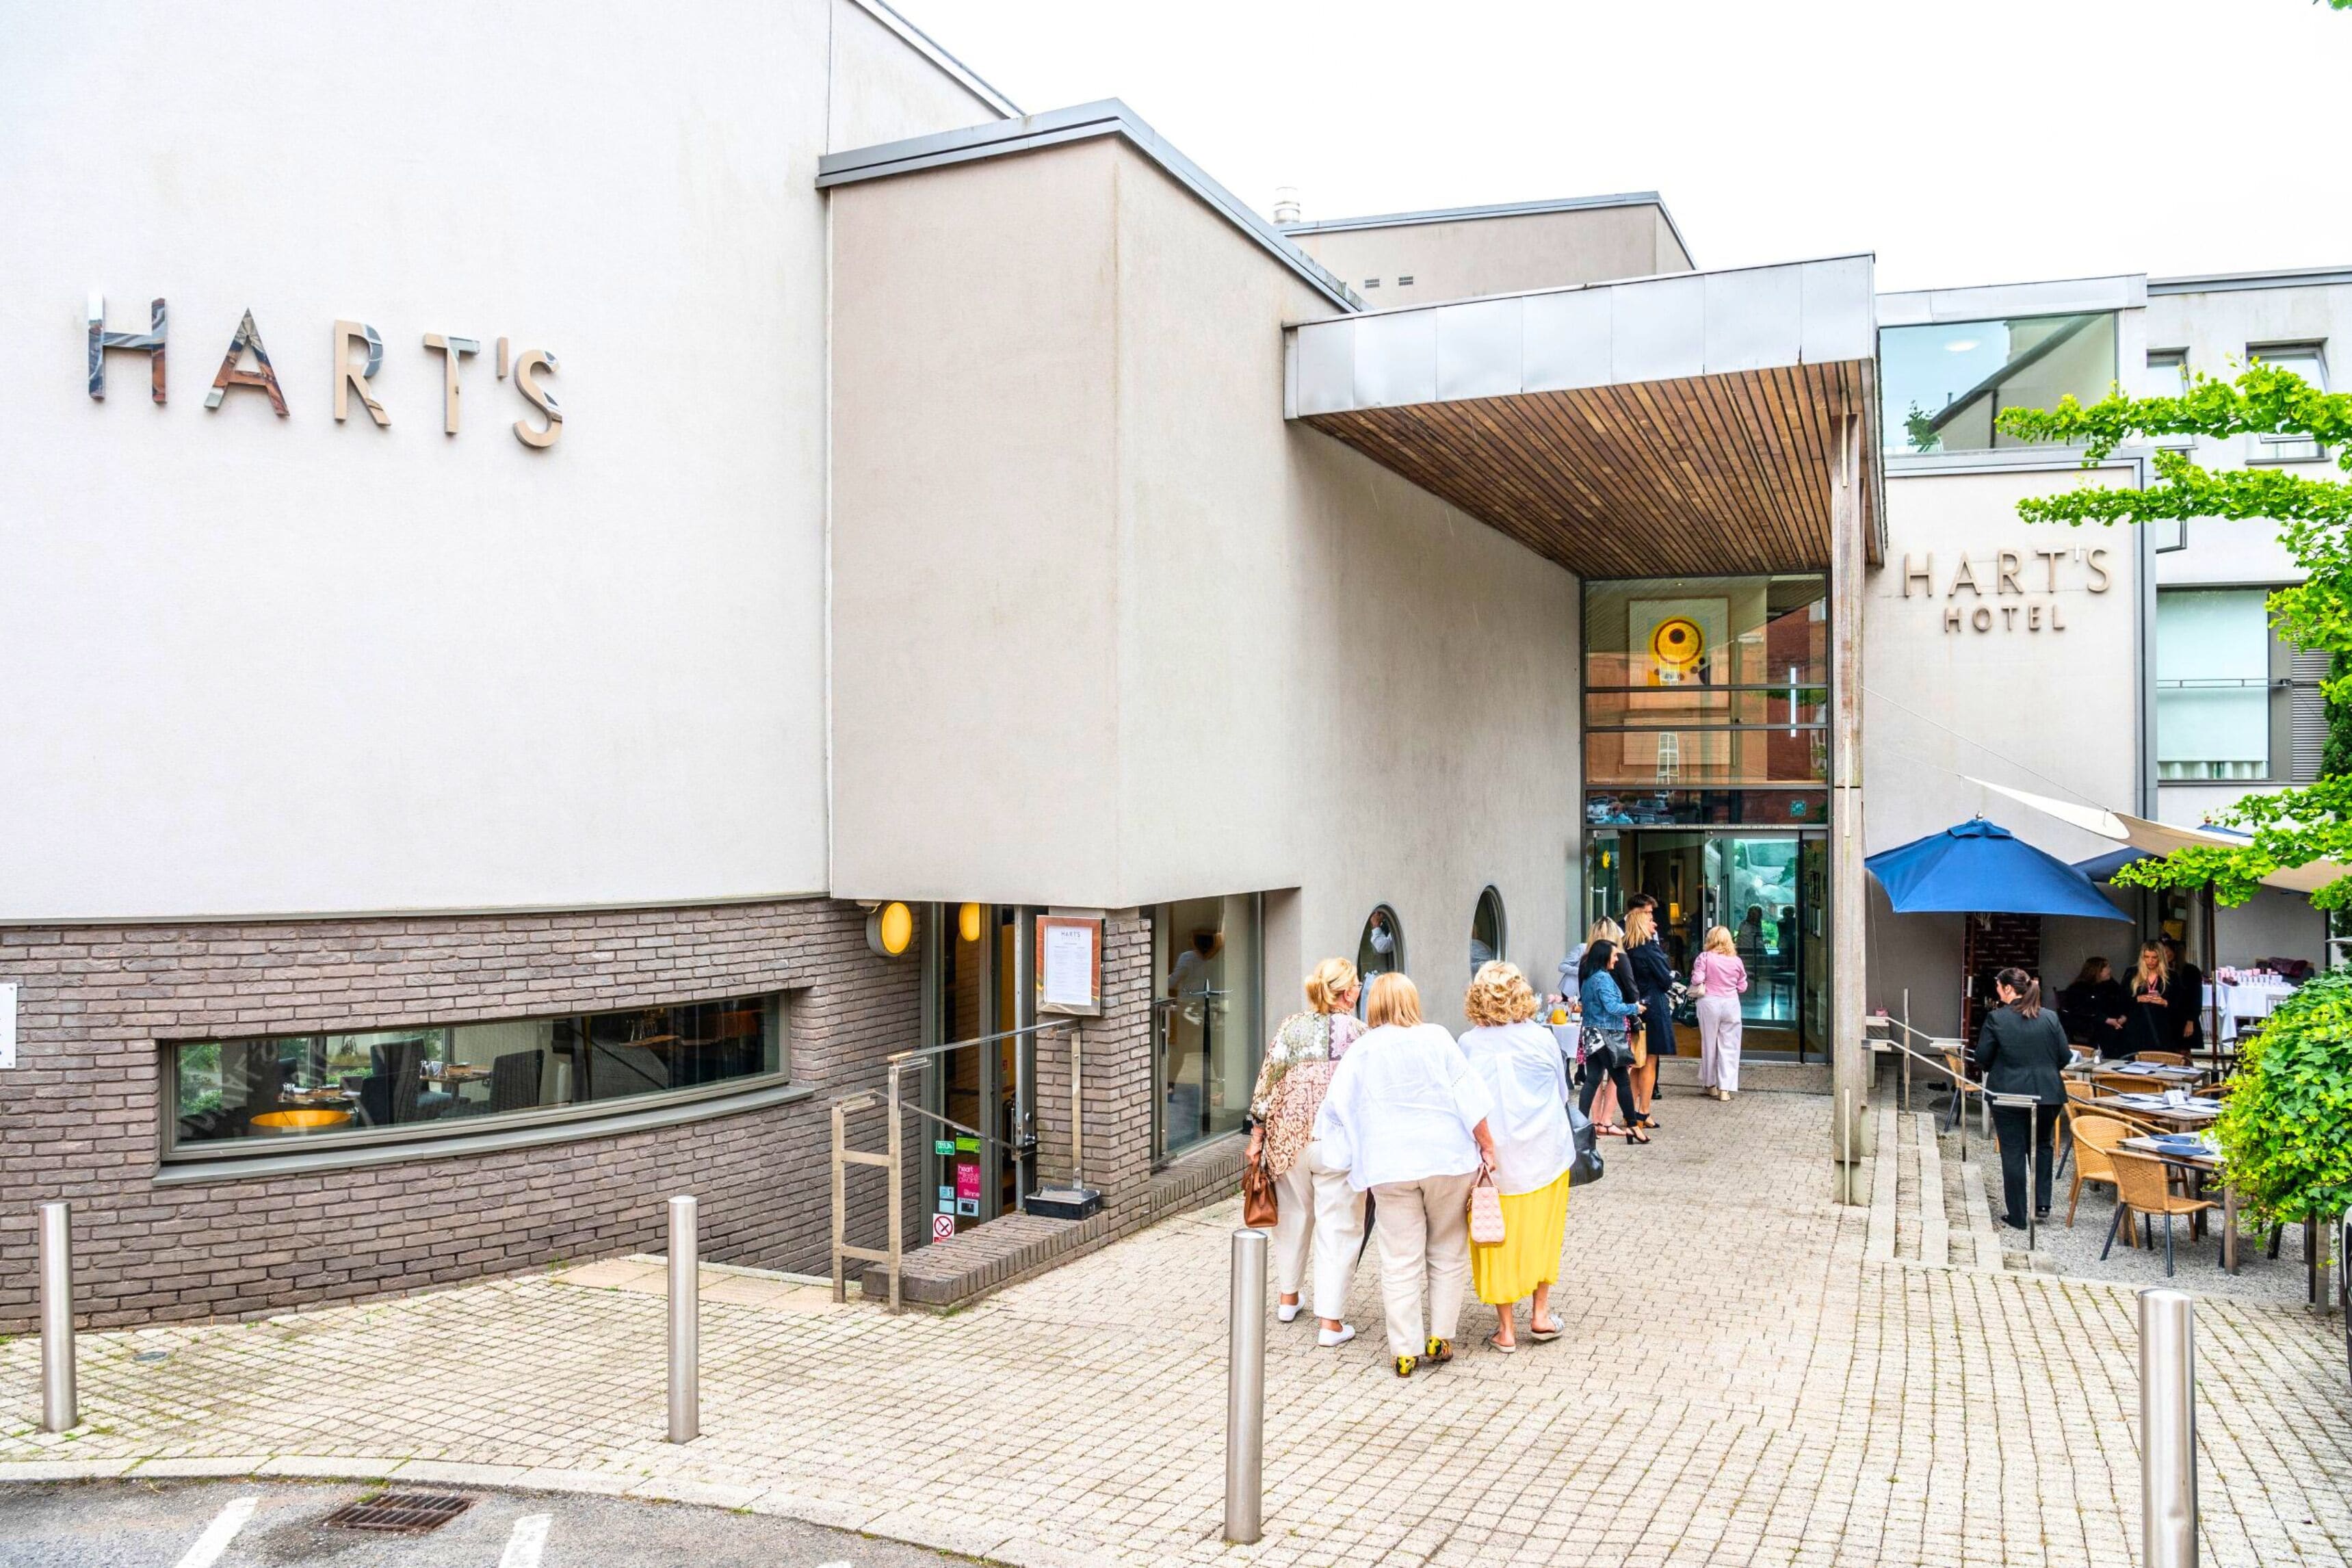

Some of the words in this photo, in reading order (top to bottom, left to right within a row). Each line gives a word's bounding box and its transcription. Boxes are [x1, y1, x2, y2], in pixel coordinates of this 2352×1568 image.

[88, 291, 563, 448] HART'S
[1904, 543, 2111, 597] HART'S
[1944, 603, 2066, 633] HOTEL
